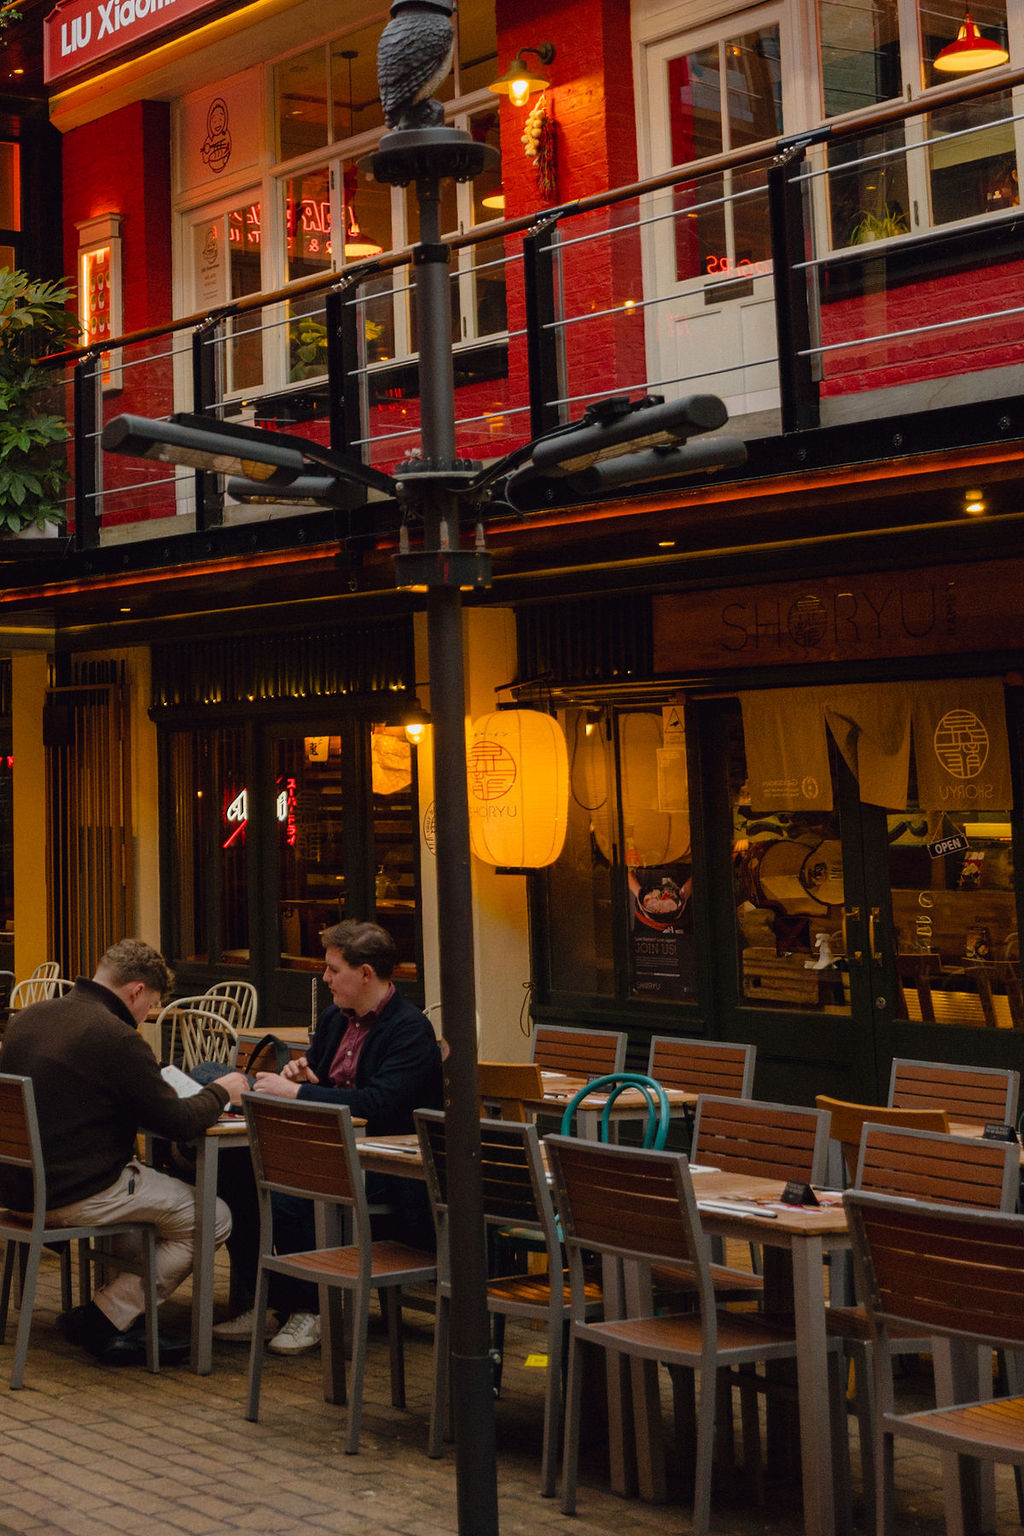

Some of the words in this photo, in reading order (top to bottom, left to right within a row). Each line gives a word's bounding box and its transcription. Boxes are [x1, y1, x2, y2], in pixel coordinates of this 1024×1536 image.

[61, 11, 92, 57] LIU
[470, 805, 517, 818] HORYU
[935, 838, 962, 854] OPEN
[635, 943, 658, 954] JOIN
